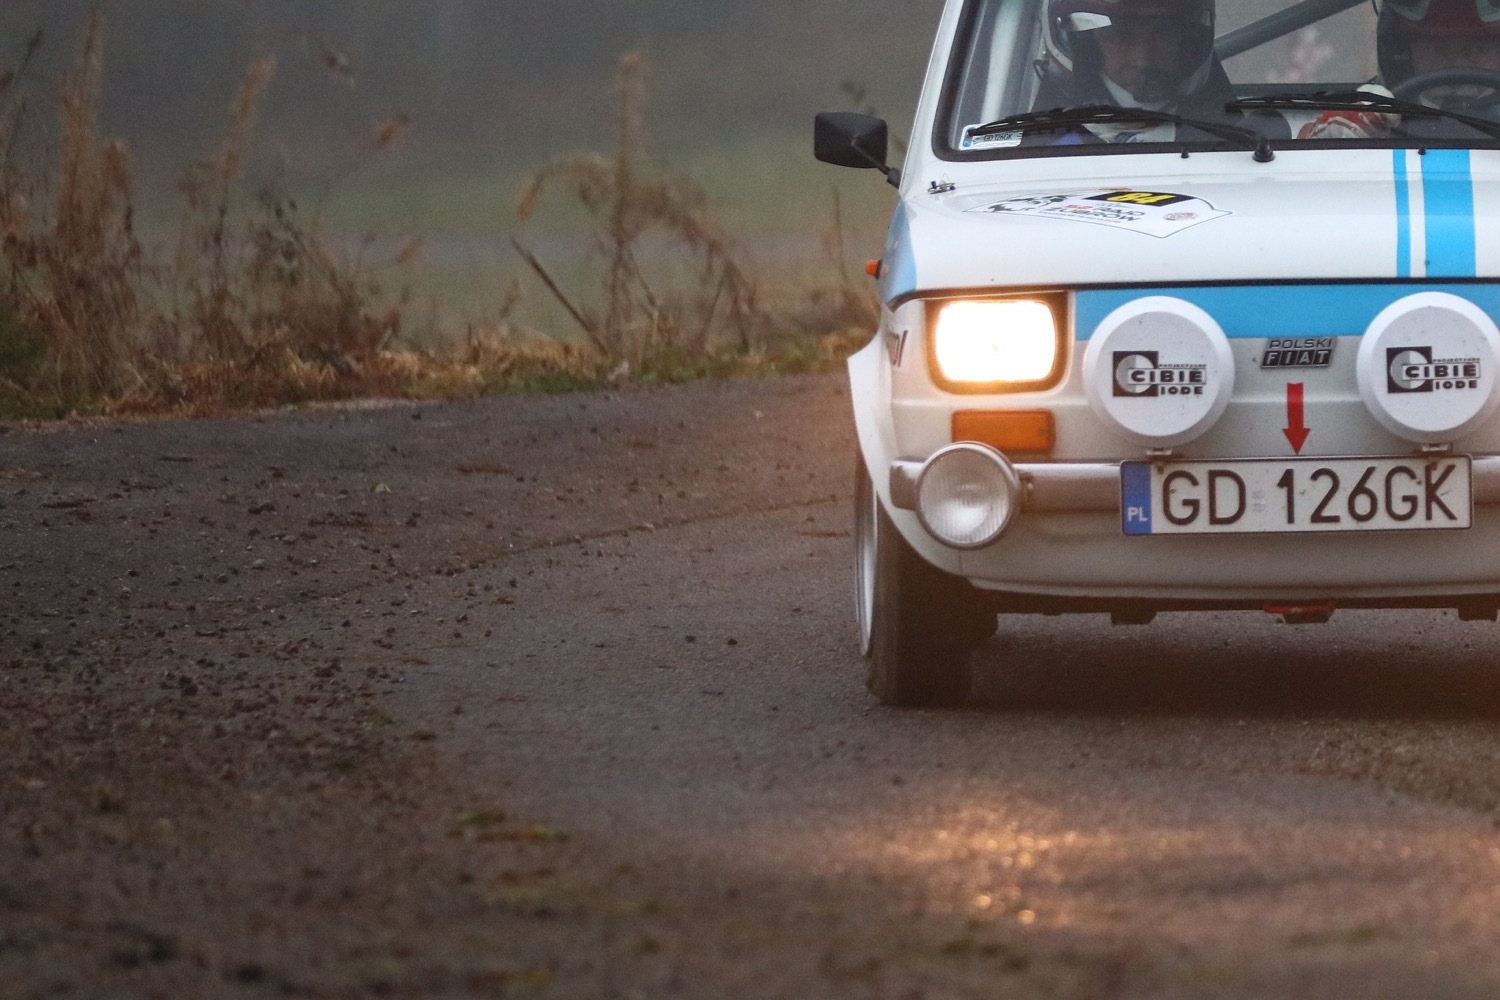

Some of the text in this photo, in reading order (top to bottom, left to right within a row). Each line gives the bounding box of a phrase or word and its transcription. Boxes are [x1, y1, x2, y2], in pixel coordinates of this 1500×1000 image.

[1268, 338, 1333, 349] POLSKI
[1265, 350, 1330, 365] FIAT
[1160, 386, 1204, 395] IODE
[1435, 380, 1478, 390] IODE
[1162, 464, 1458, 526] GD 126GK
[1127, 506, 1149, 522] PL
